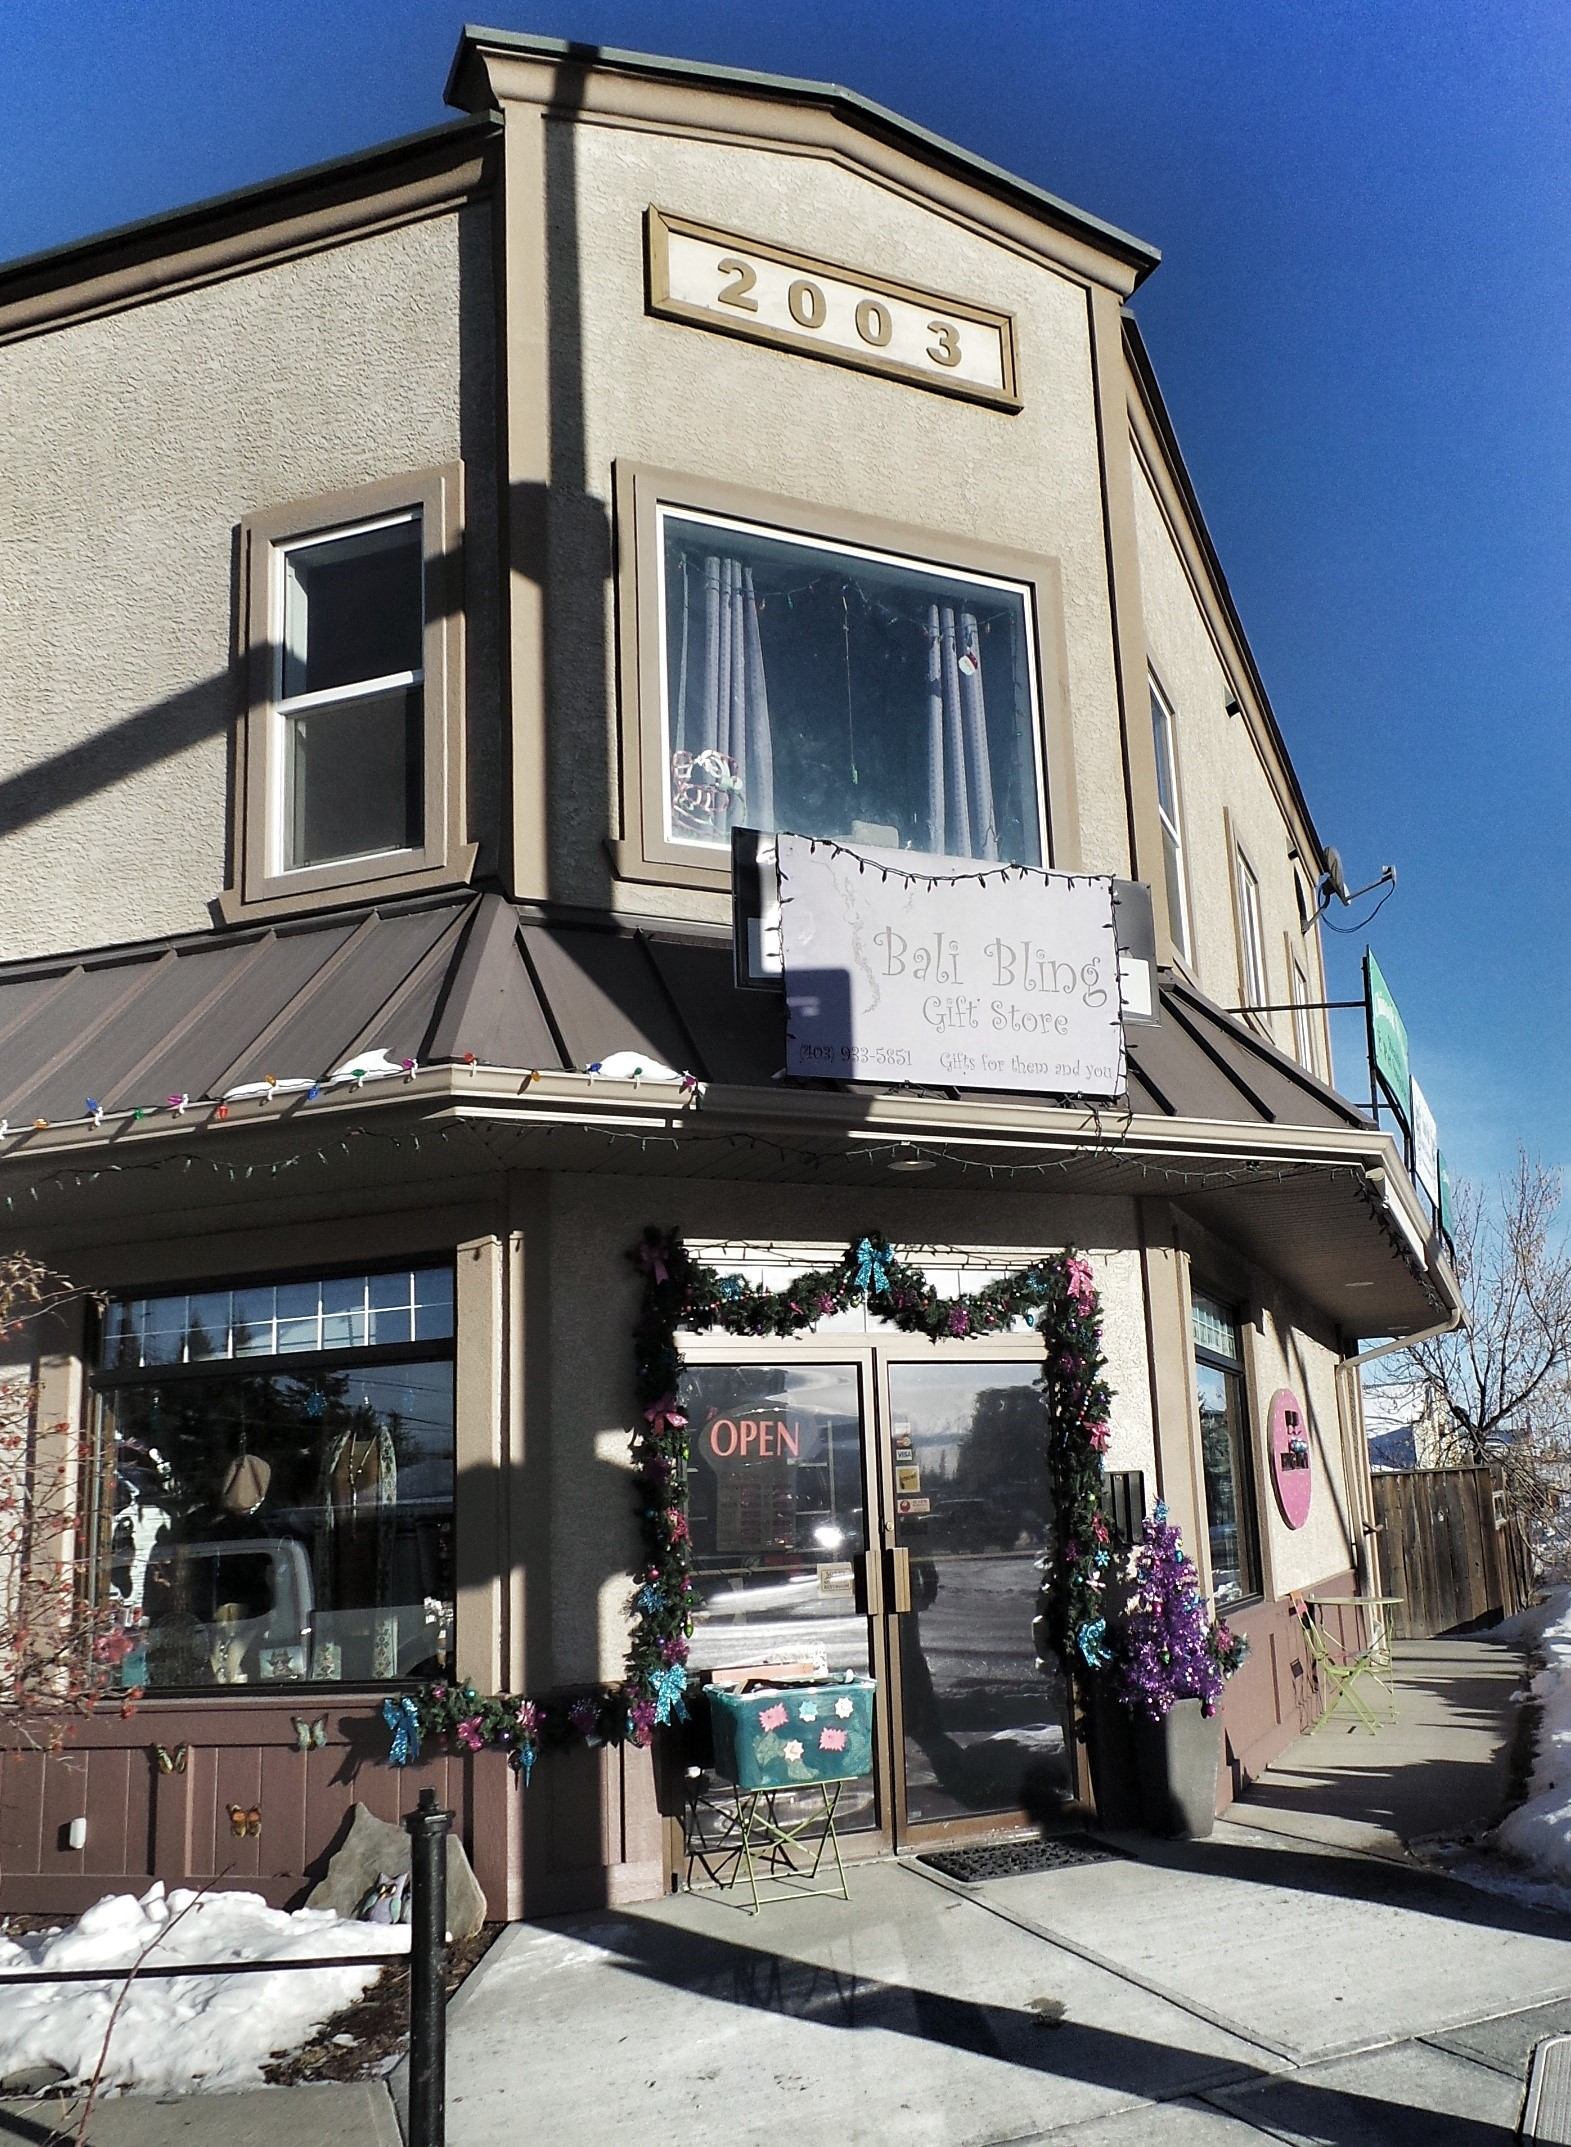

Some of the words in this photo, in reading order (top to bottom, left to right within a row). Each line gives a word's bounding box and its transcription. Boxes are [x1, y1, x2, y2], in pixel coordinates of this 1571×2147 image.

[717, 257, 962, 367] 2003
[873, 926, 964, 986] Bali
[984, 937, 1108, 1008] Bling
[922, 995, 978, 1034] Gift
[991, 1000, 1069, 1035] Store
[799, 1043, 834, 1064] (403)
[840, 1046, 913, 1066] 933-5851
[939, 1052, 976, 1072] Gifts
[981, 1054, 1005, 1070] for
[1011, 1055, 1049, 1075] them
[1055, 1059, 1080, 1076] and
[1083, 1066, 1114, 1080] you
[710, 1419, 801, 1457] OPEN
[897, 1450, 912, 1458] VISA
